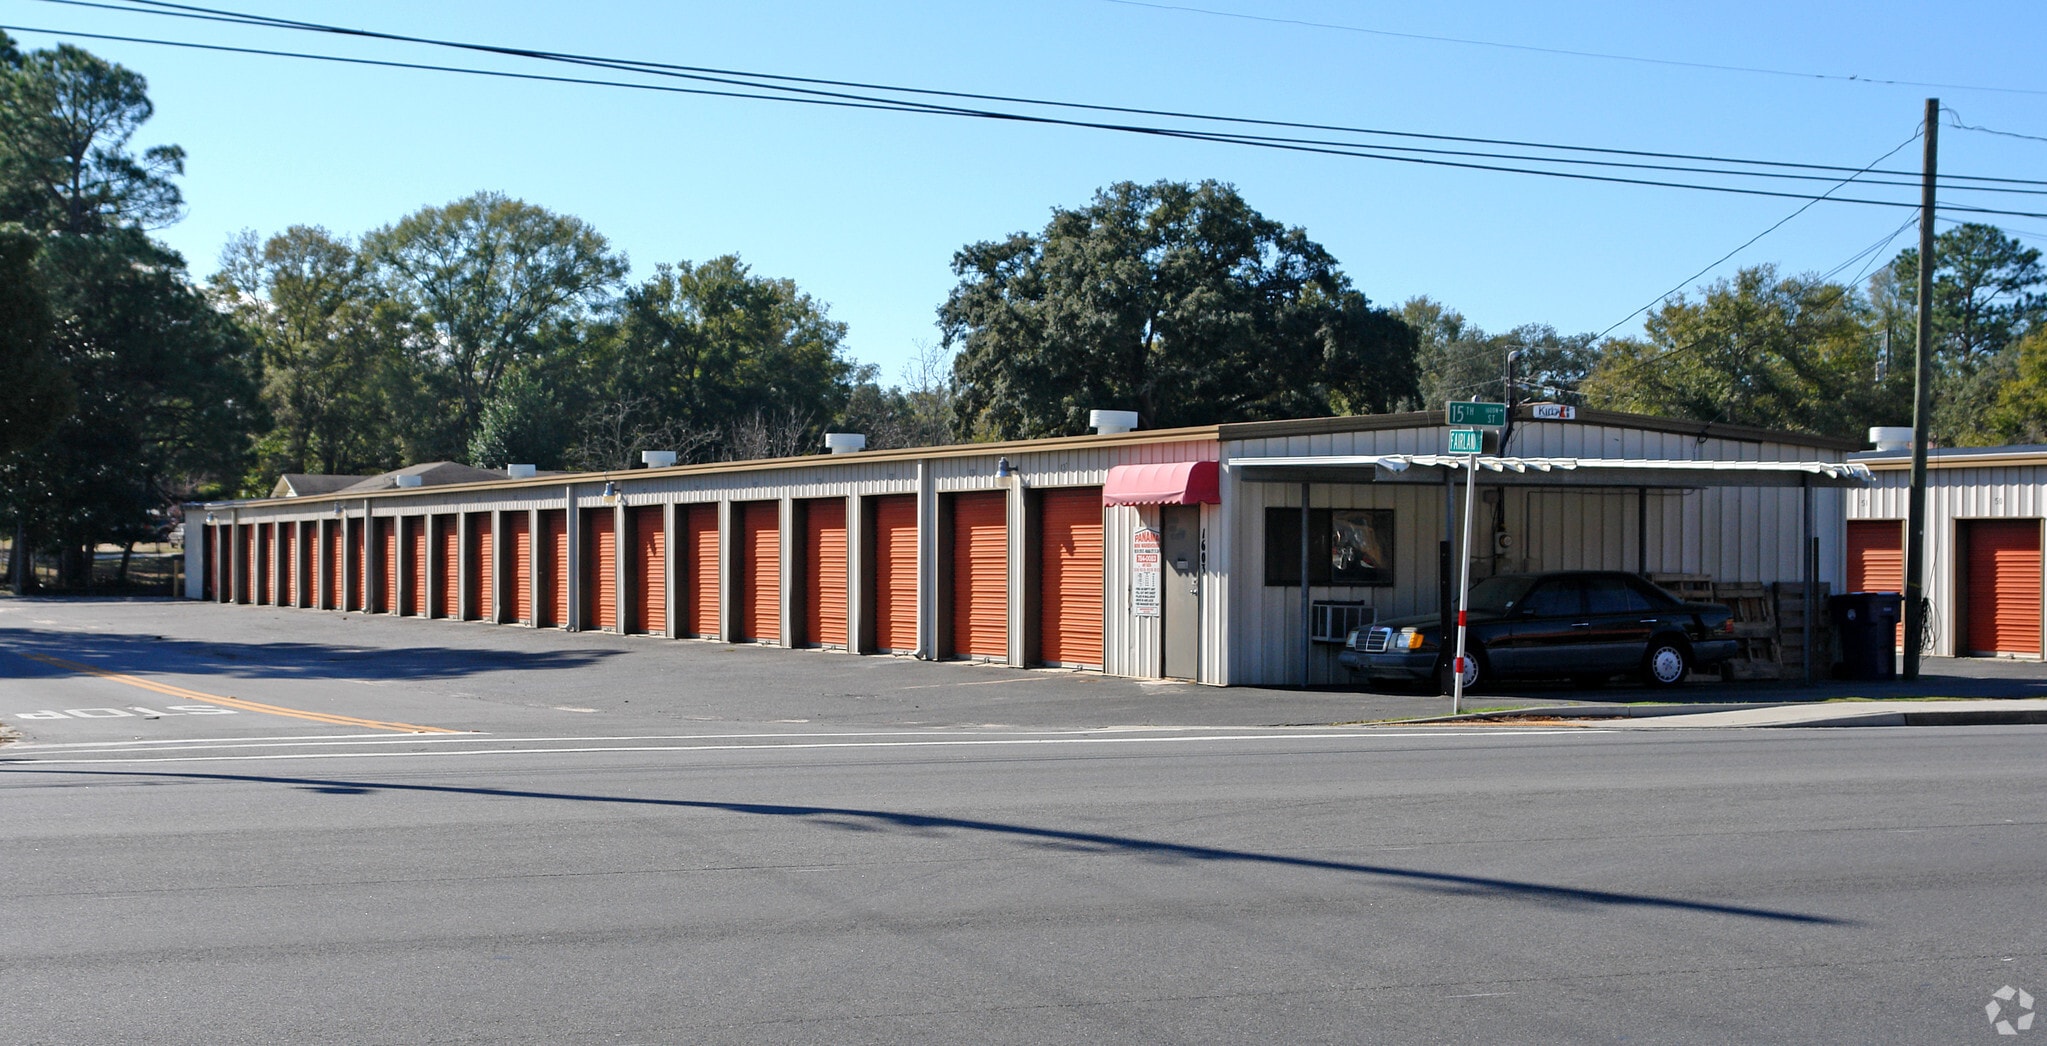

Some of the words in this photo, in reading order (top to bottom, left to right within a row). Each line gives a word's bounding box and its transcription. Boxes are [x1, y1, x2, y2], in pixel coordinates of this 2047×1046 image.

[1487, 414, 1496, 424] ST
[1861, 499, 1868, 507] 51
[15, 705, 239, 719] STOP
